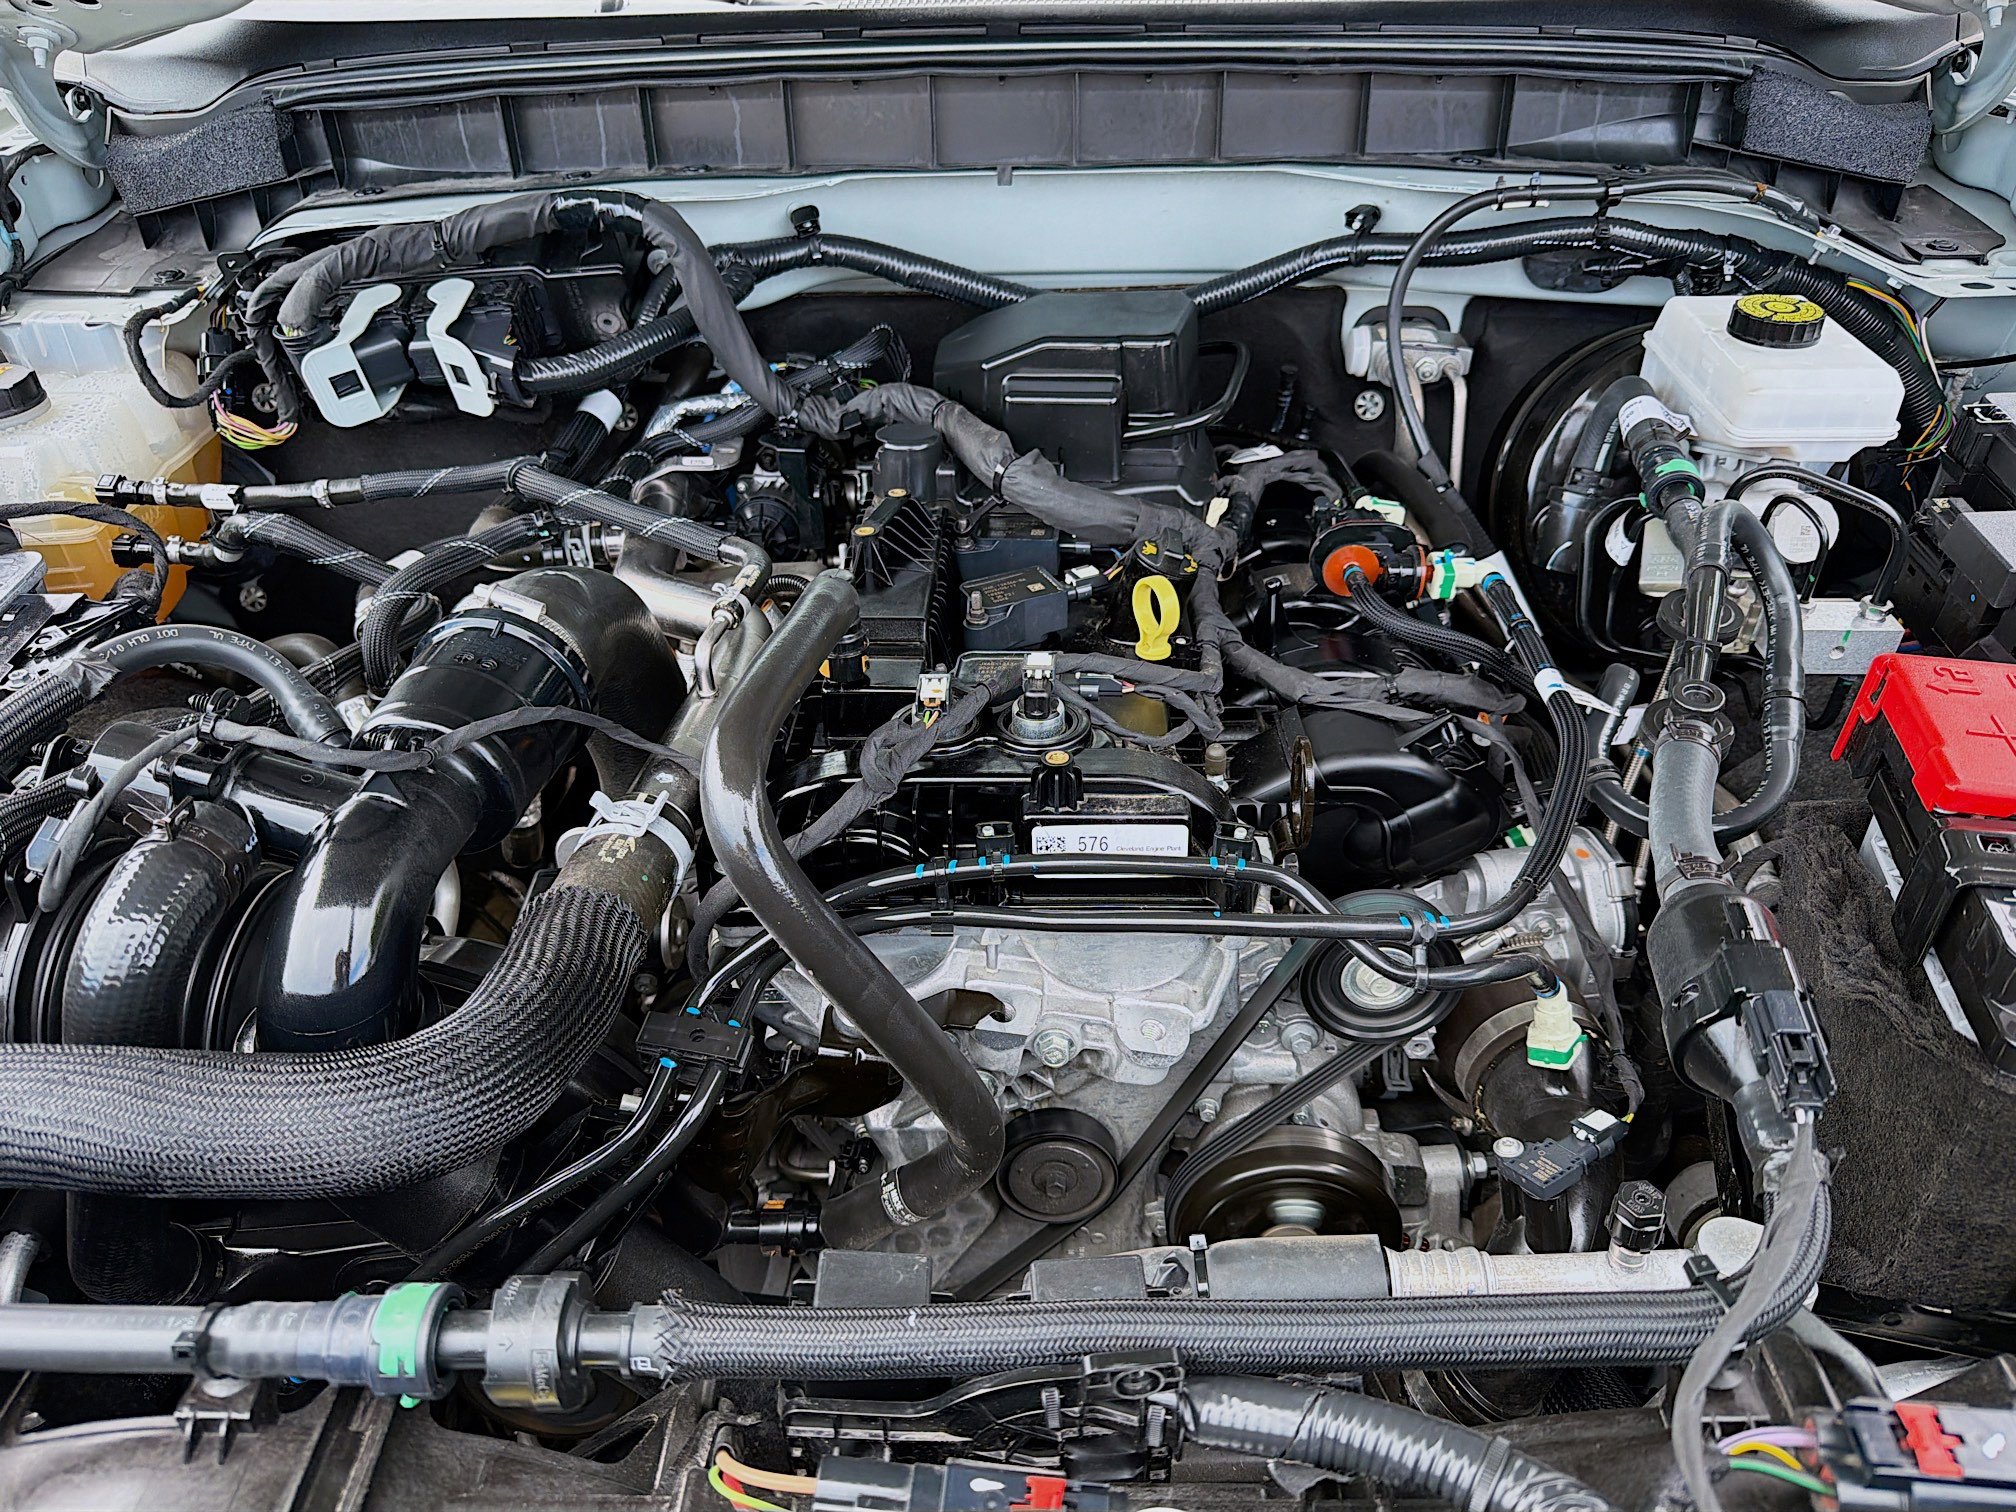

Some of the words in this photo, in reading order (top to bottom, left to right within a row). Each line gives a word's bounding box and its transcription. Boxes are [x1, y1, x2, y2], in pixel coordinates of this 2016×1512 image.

[1746, 555, 1762, 576] TYPE
[155, 627, 179, 639] DOT
[229, 634, 256, 652] TYPE
[1078, 836, 1109, 852] 576
[1146, 845, 1164, 853] Engine
